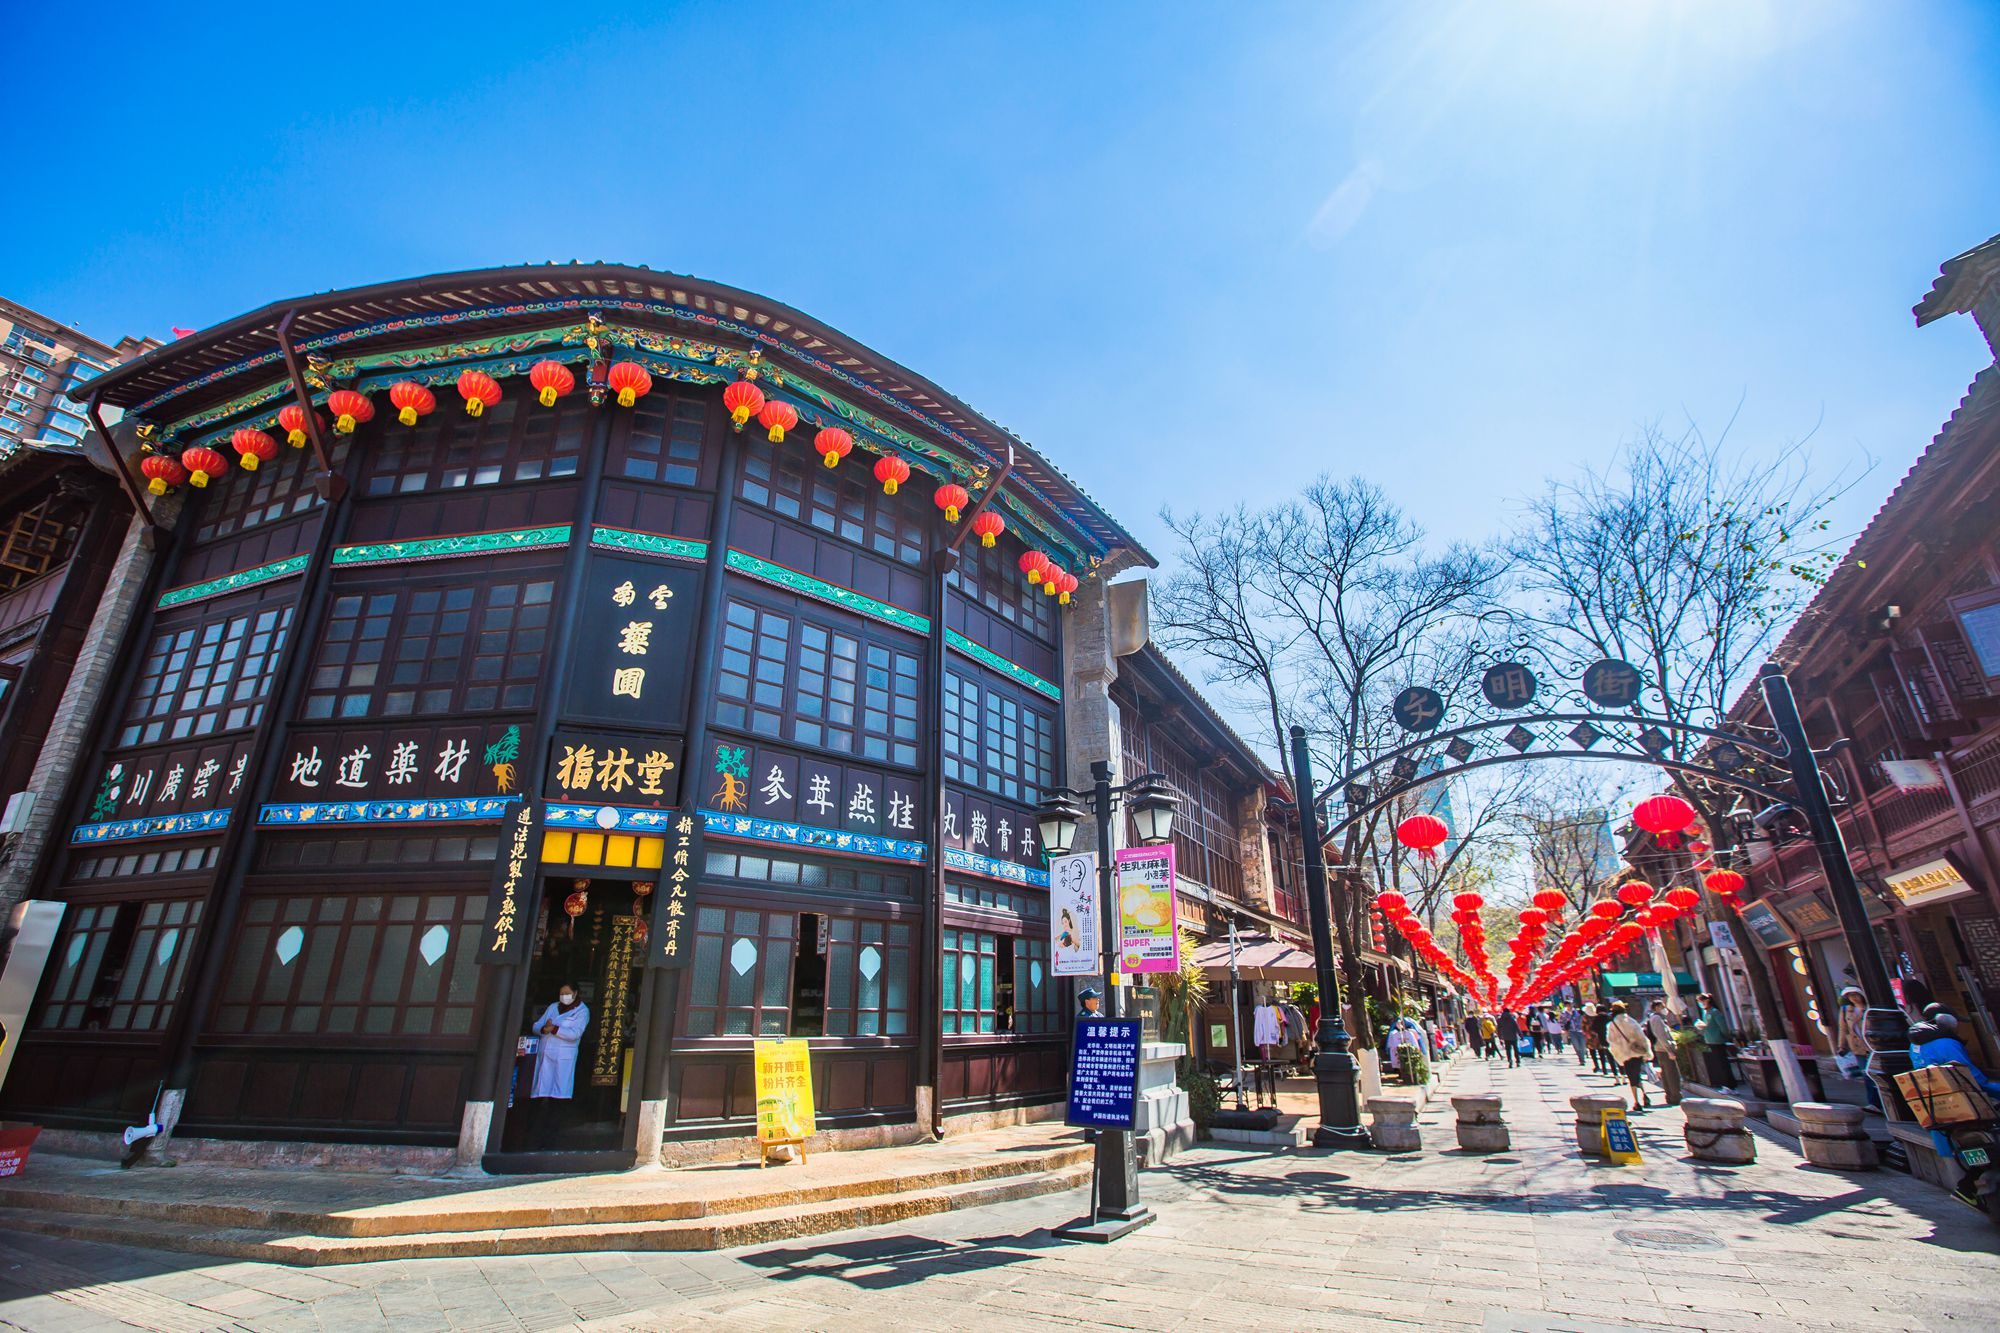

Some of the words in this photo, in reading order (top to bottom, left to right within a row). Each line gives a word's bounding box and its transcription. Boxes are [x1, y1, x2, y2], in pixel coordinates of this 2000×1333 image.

[1403, 668, 1634, 727] 文明街
[556, 744, 675, 796] 福林堂
[1123, 938, 1151, 948] SUPER
[1087, 1026, 1131, 1038] 温馨提示
[763, 1060, 806, 1074] 新开鹿茸
[763, 1076, 807, 1090] 粉片齐全
